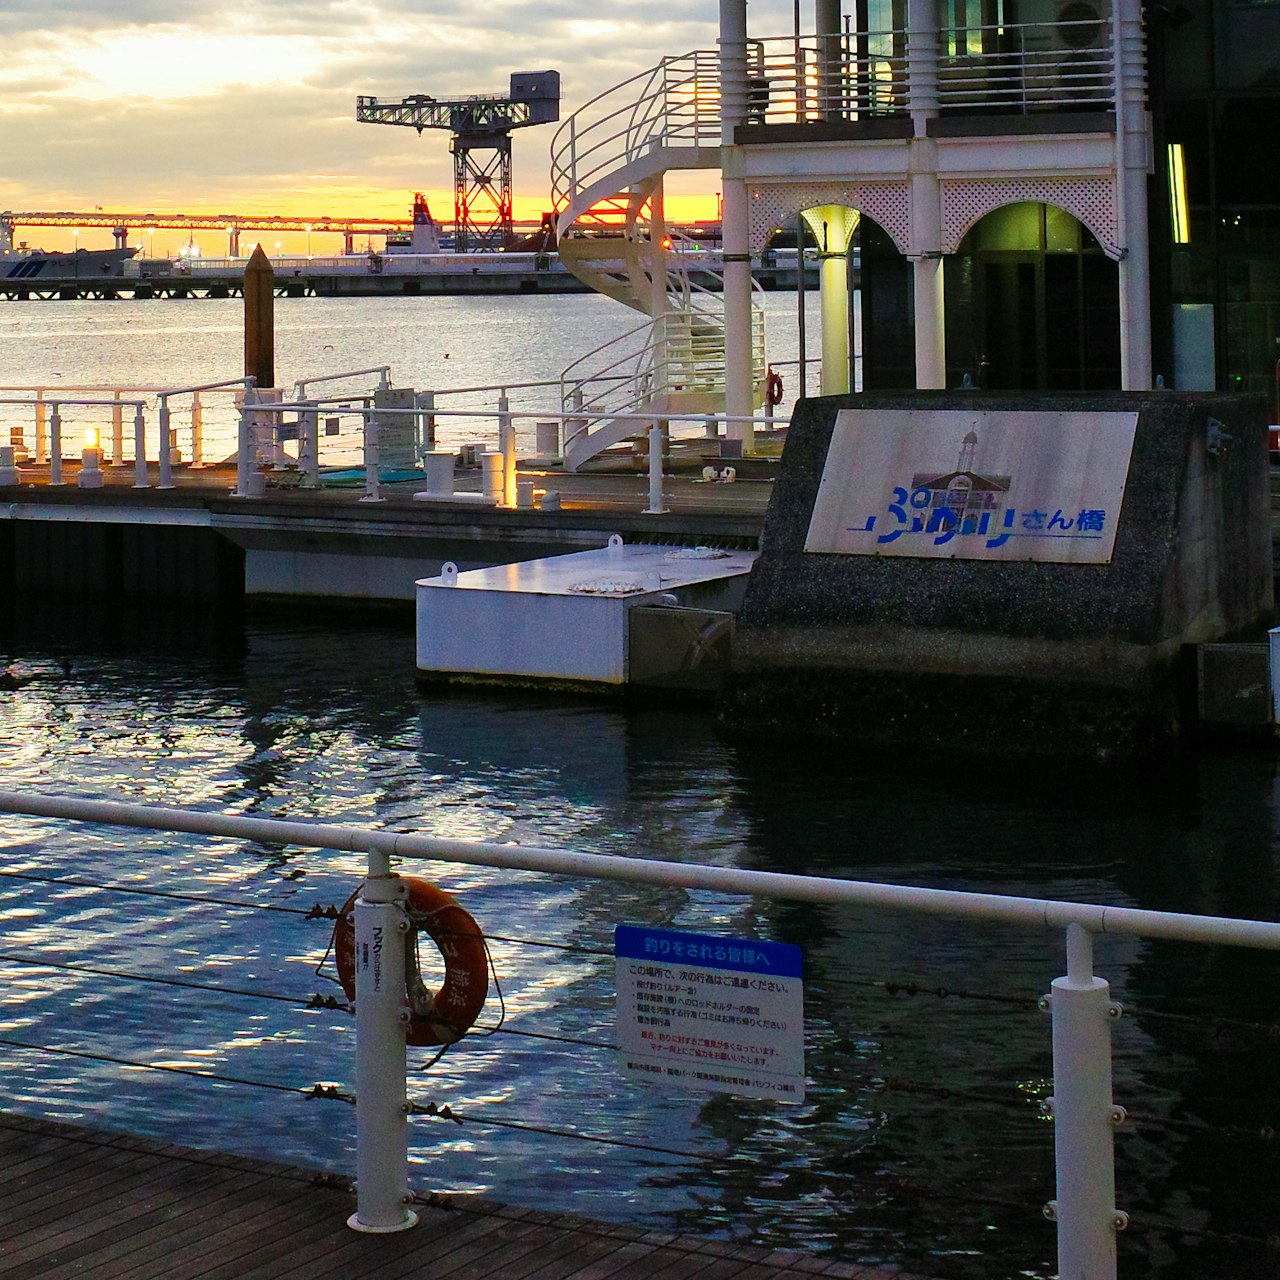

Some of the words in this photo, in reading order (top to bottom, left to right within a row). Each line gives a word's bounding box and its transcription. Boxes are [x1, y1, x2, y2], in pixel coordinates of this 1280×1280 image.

[847, 487, 1107, 549] ぷかりさん橋
[645, 937, 770, 966] 釣りをされる皆様へ
